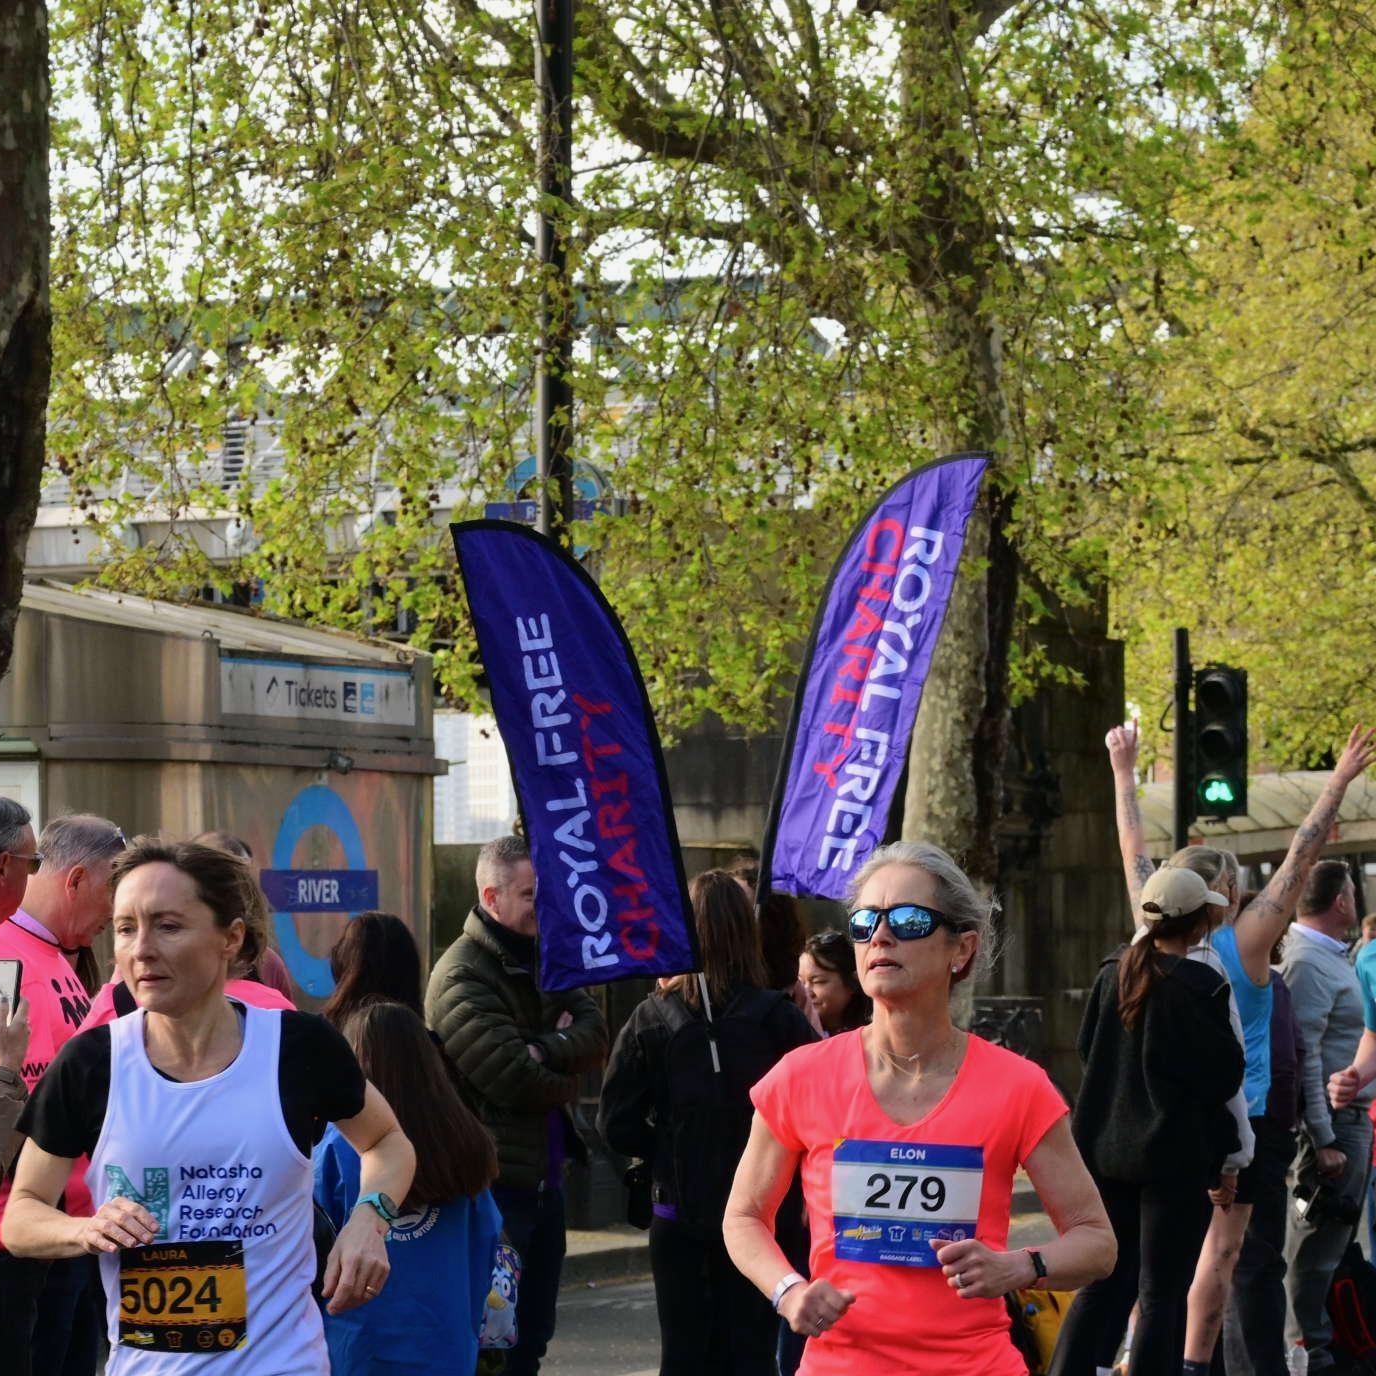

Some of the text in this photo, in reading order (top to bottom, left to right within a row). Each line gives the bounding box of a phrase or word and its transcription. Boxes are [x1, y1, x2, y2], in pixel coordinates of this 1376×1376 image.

[814, 518, 904, 788] CHARITY
[285, 680, 337, 709] Tickets
[818, 525, 944, 872] ROYAL FREE
[516, 611, 620, 972] ROYAL FREE
[572, 693, 660, 961] CHARITY
[298, 879, 340, 903] RIVER
[890, 1147, 927, 1160] ELON
[180, 1164, 263, 1181] Natasha
[182, 1185, 247, 1202] Allergy
[864, 1173, 946, 1212] 279
[179, 1205, 264, 1220] Research
[179, 1222, 278, 1240] Foundation
[143, 1249, 188, 1261] LAURA
[120, 1275, 222, 1315] 5024
